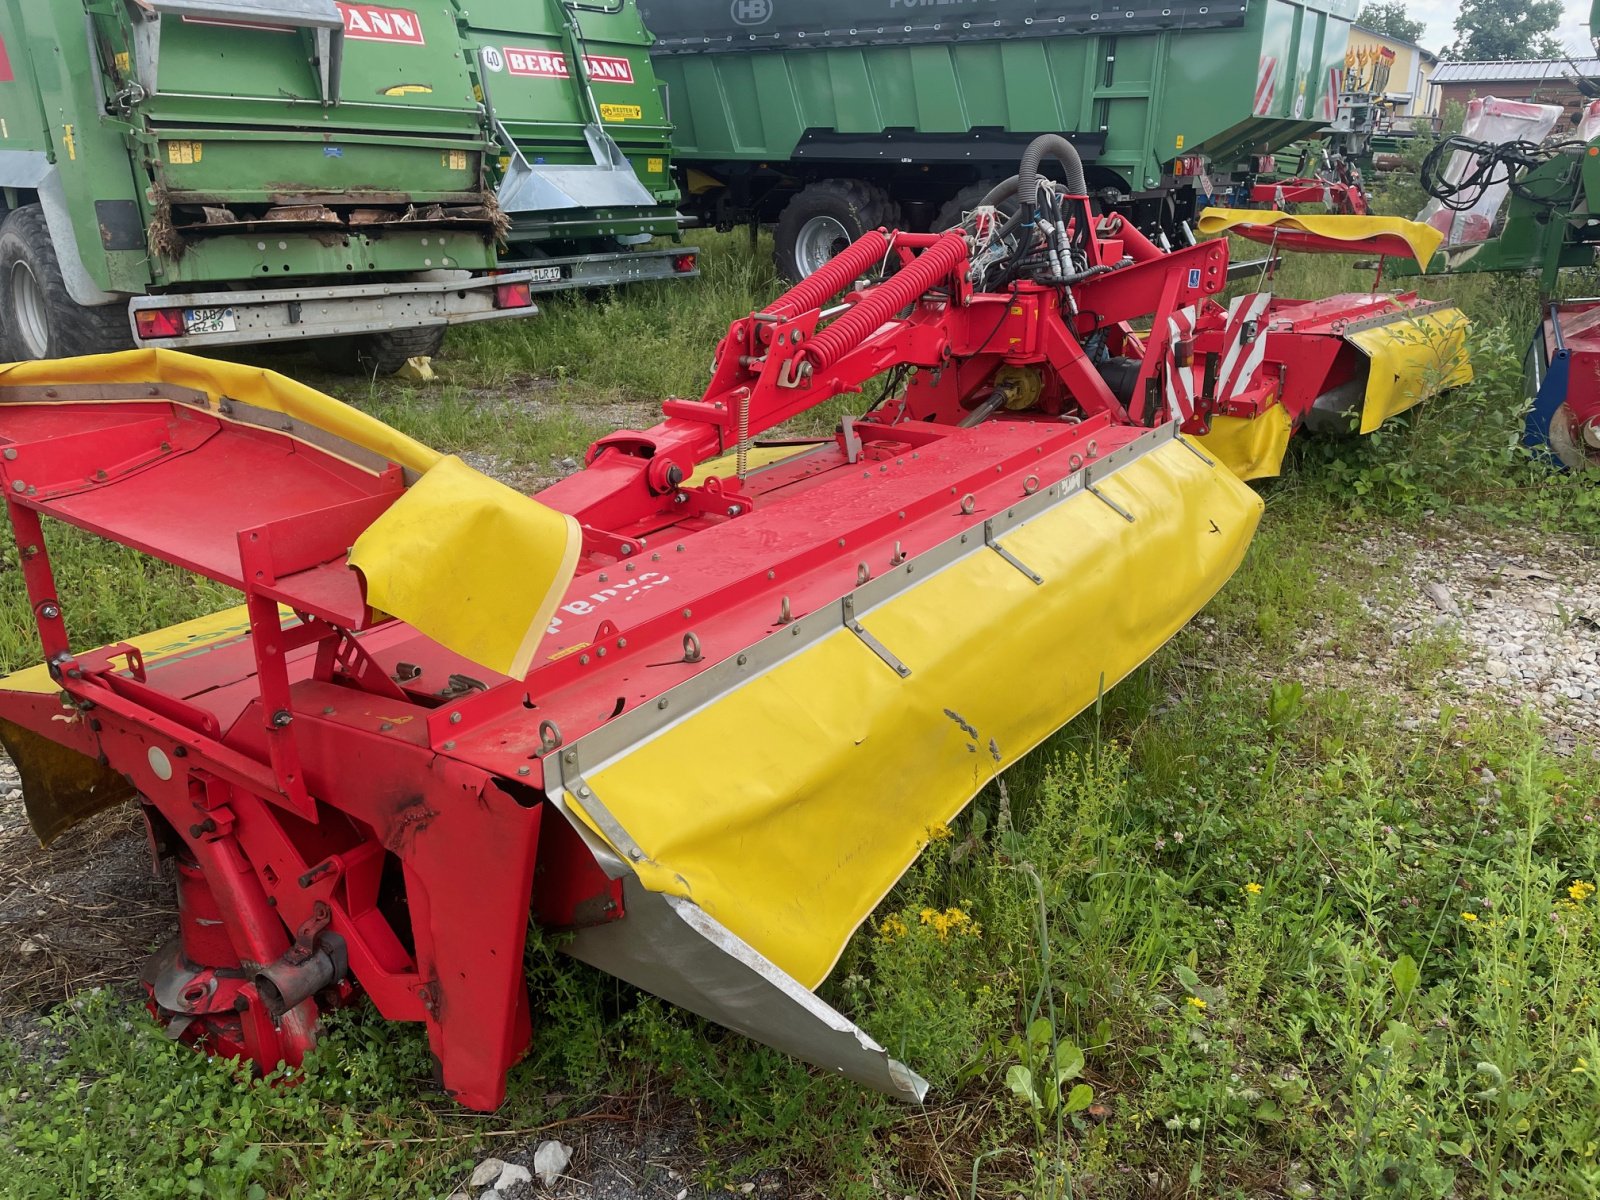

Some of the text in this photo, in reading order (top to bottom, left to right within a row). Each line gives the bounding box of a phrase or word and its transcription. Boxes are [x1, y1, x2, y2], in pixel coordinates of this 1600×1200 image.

[738, 0, 767, 19] HB
[337, 8, 415, 37] ANN
[486, 51, 499, 67] 40
